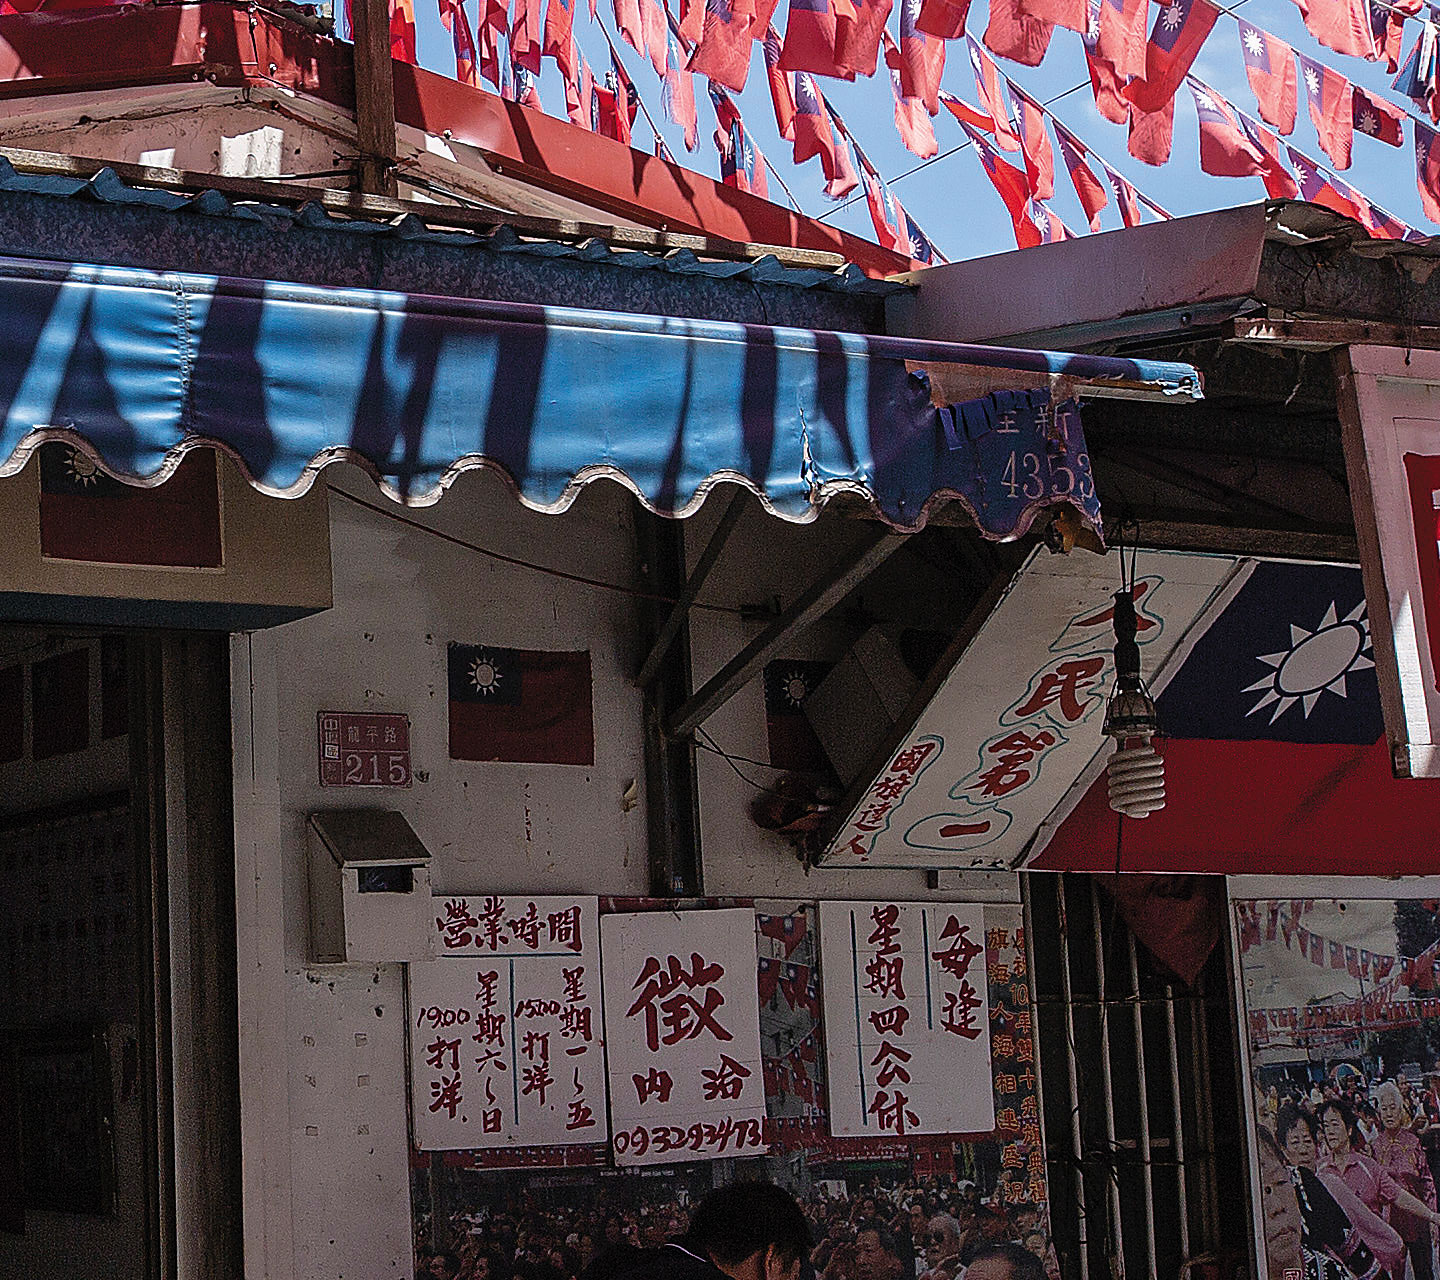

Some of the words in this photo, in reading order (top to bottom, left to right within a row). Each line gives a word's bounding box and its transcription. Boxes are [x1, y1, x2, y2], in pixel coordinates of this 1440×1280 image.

[345, 753, 407, 783] 215
[836, 742, 935, 857] 國旗達人
[436, 897, 582, 952] 營業時間
[932, 915, 983, 1040] 每逢
[864, 904, 921, 1135] 星期四公休
